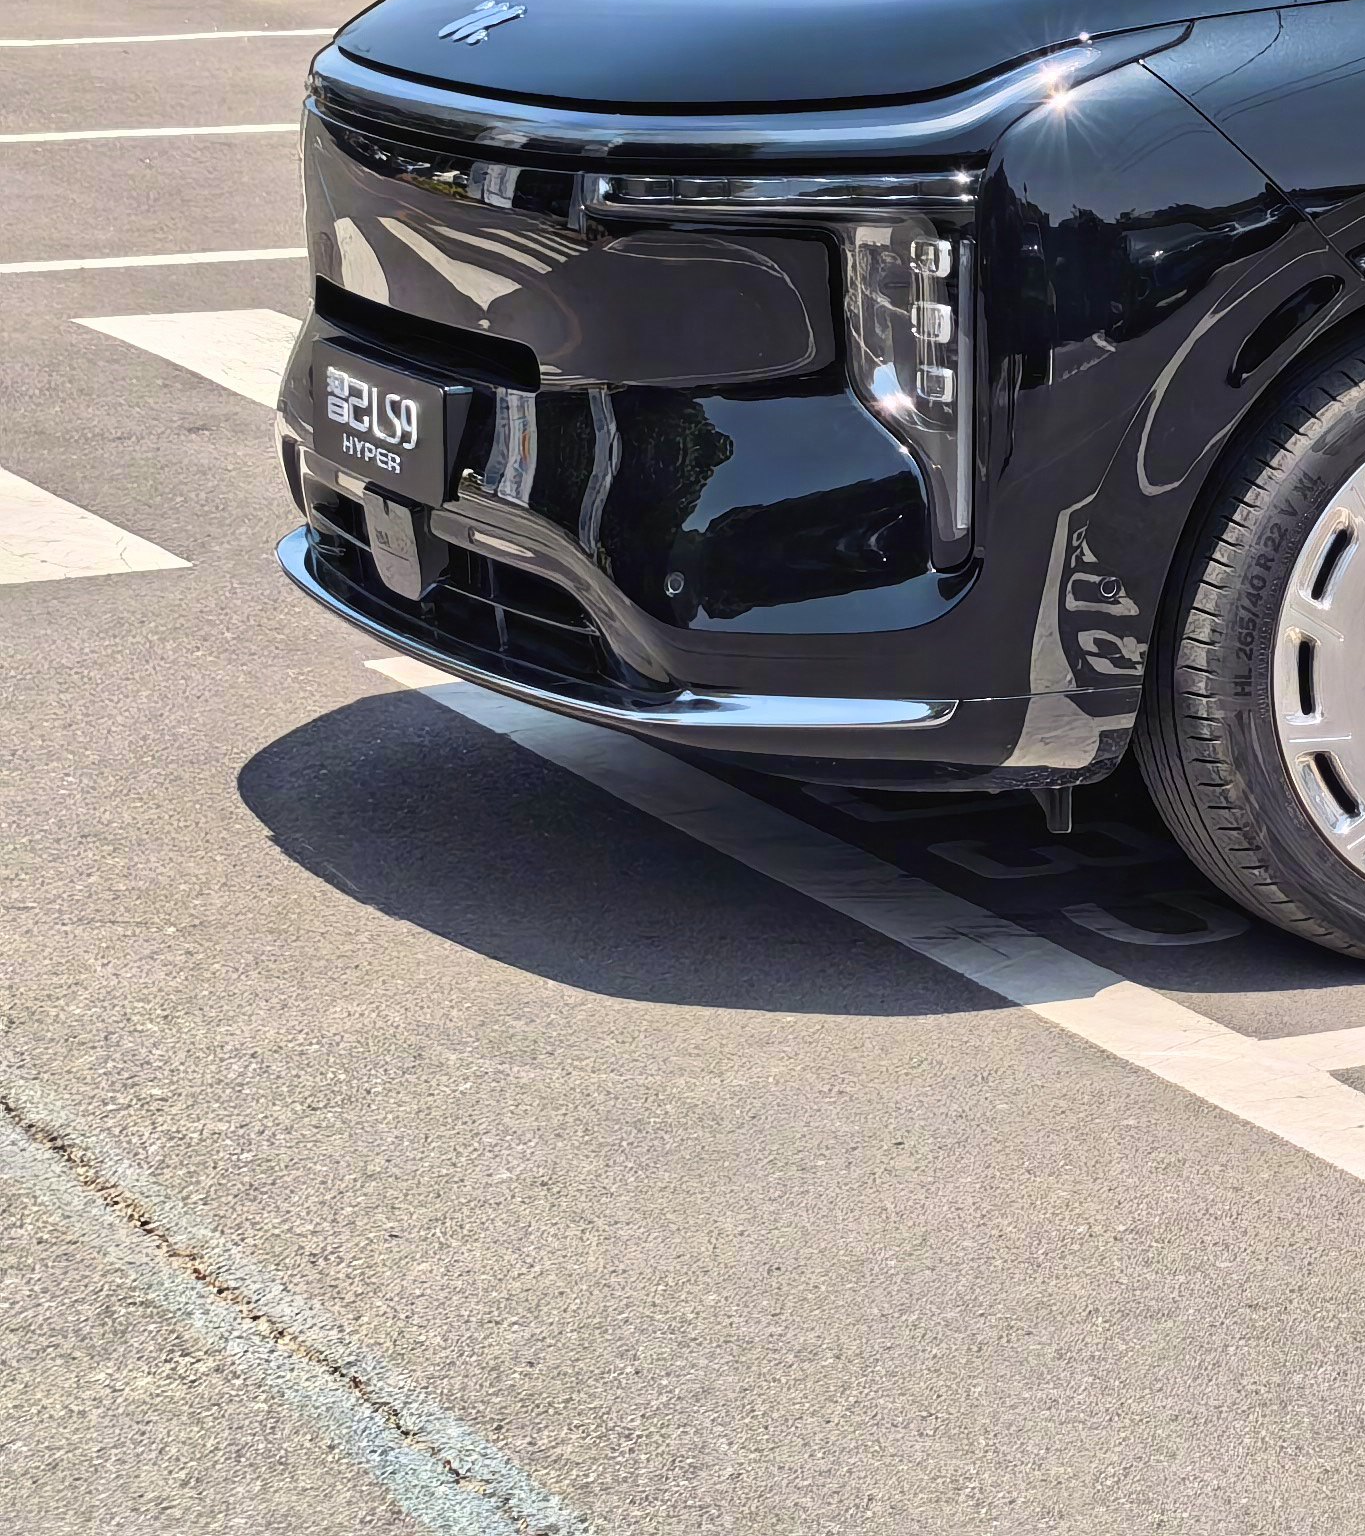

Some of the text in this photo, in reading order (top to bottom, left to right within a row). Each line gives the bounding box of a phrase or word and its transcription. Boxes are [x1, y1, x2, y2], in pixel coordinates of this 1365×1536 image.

[342, 432, 402, 475] HYPER
[1263, 521, 1289, 554] 22
[1254, 551, 1276, 573] R
[1236, 576, 1268, 662] 265/40
